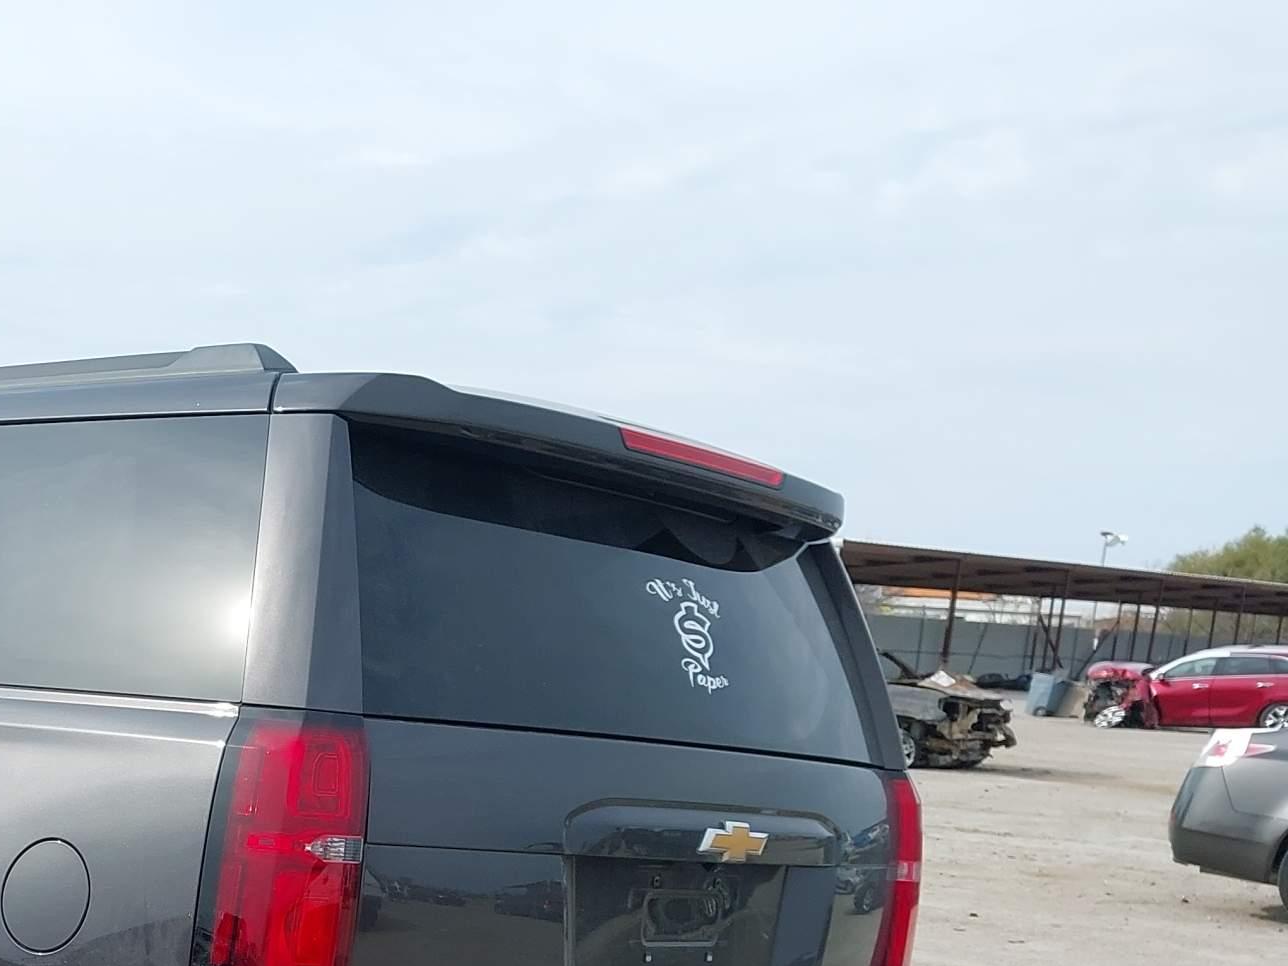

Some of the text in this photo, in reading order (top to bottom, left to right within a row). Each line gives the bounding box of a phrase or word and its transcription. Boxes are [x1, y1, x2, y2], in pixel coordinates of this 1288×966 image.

[646, 578, 721, 618] It's Just
[681, 658, 729, 695] Paper
